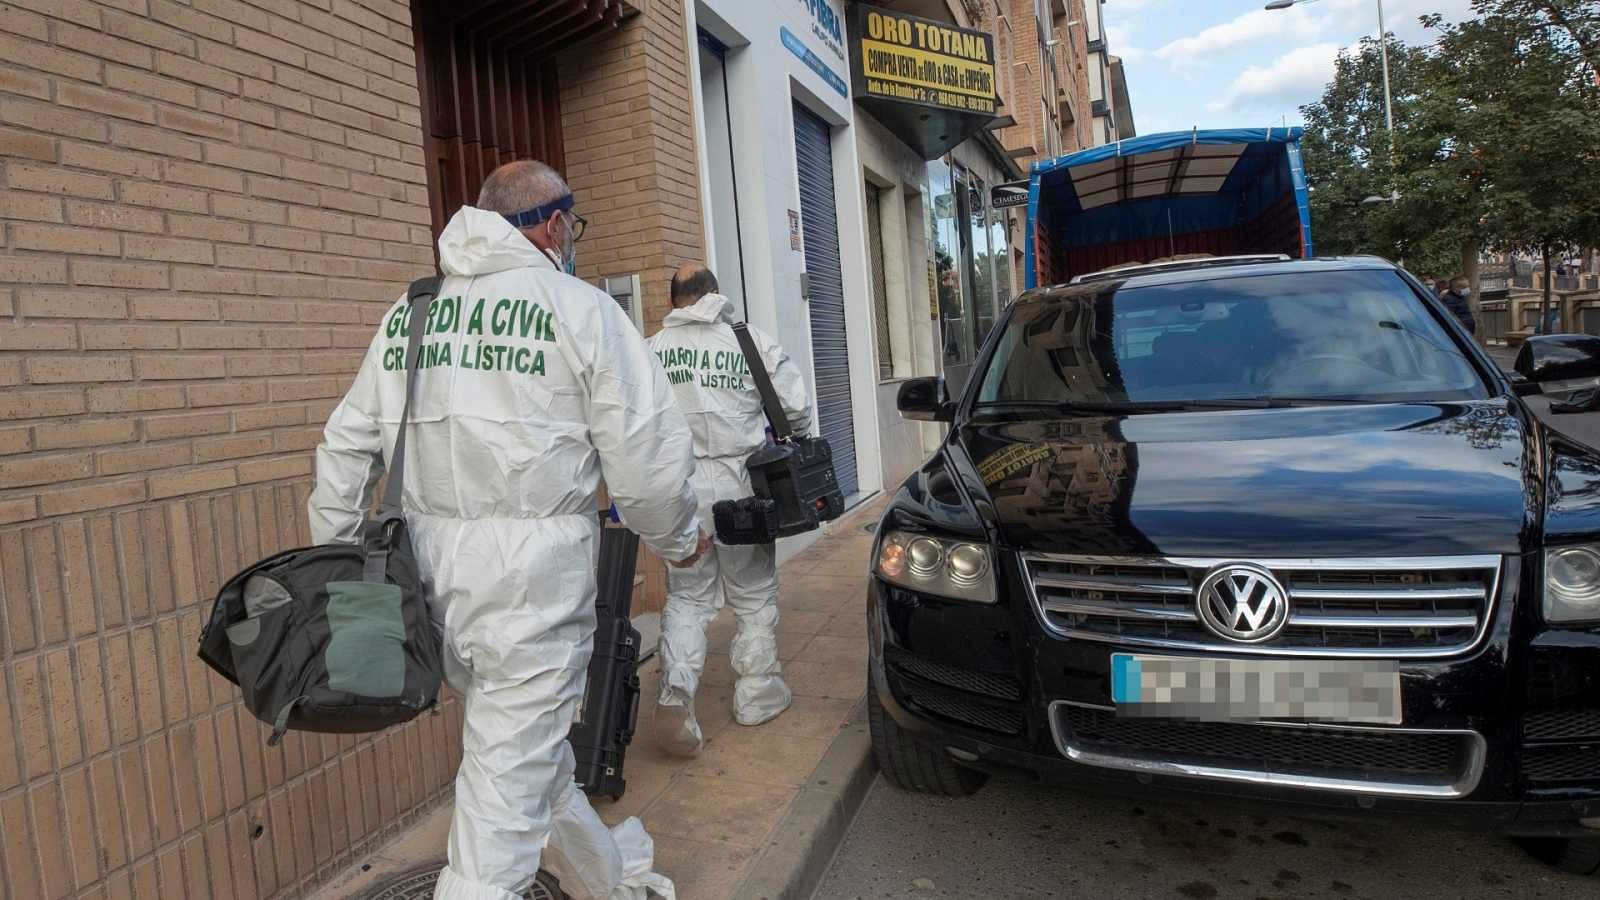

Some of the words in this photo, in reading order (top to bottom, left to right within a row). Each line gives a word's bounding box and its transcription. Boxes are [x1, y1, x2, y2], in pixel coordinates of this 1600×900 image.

[868, 12, 912, 46] ORO
[915, 22, 988, 61] TOTANA
[868, 48, 897, 76] COMPRA
[897, 54, 918, 80] VENTA
[923, 59, 936, 84] ORO
[937, 65, 943, 85] &
[943, 63, 960, 88] CASA
[965, 67, 991, 94] EMPEÑOS
[386, 296, 461, 338] GURDI
[491, 298, 557, 342] CIVIL
[460, 340, 546, 376] LÍSTICA
